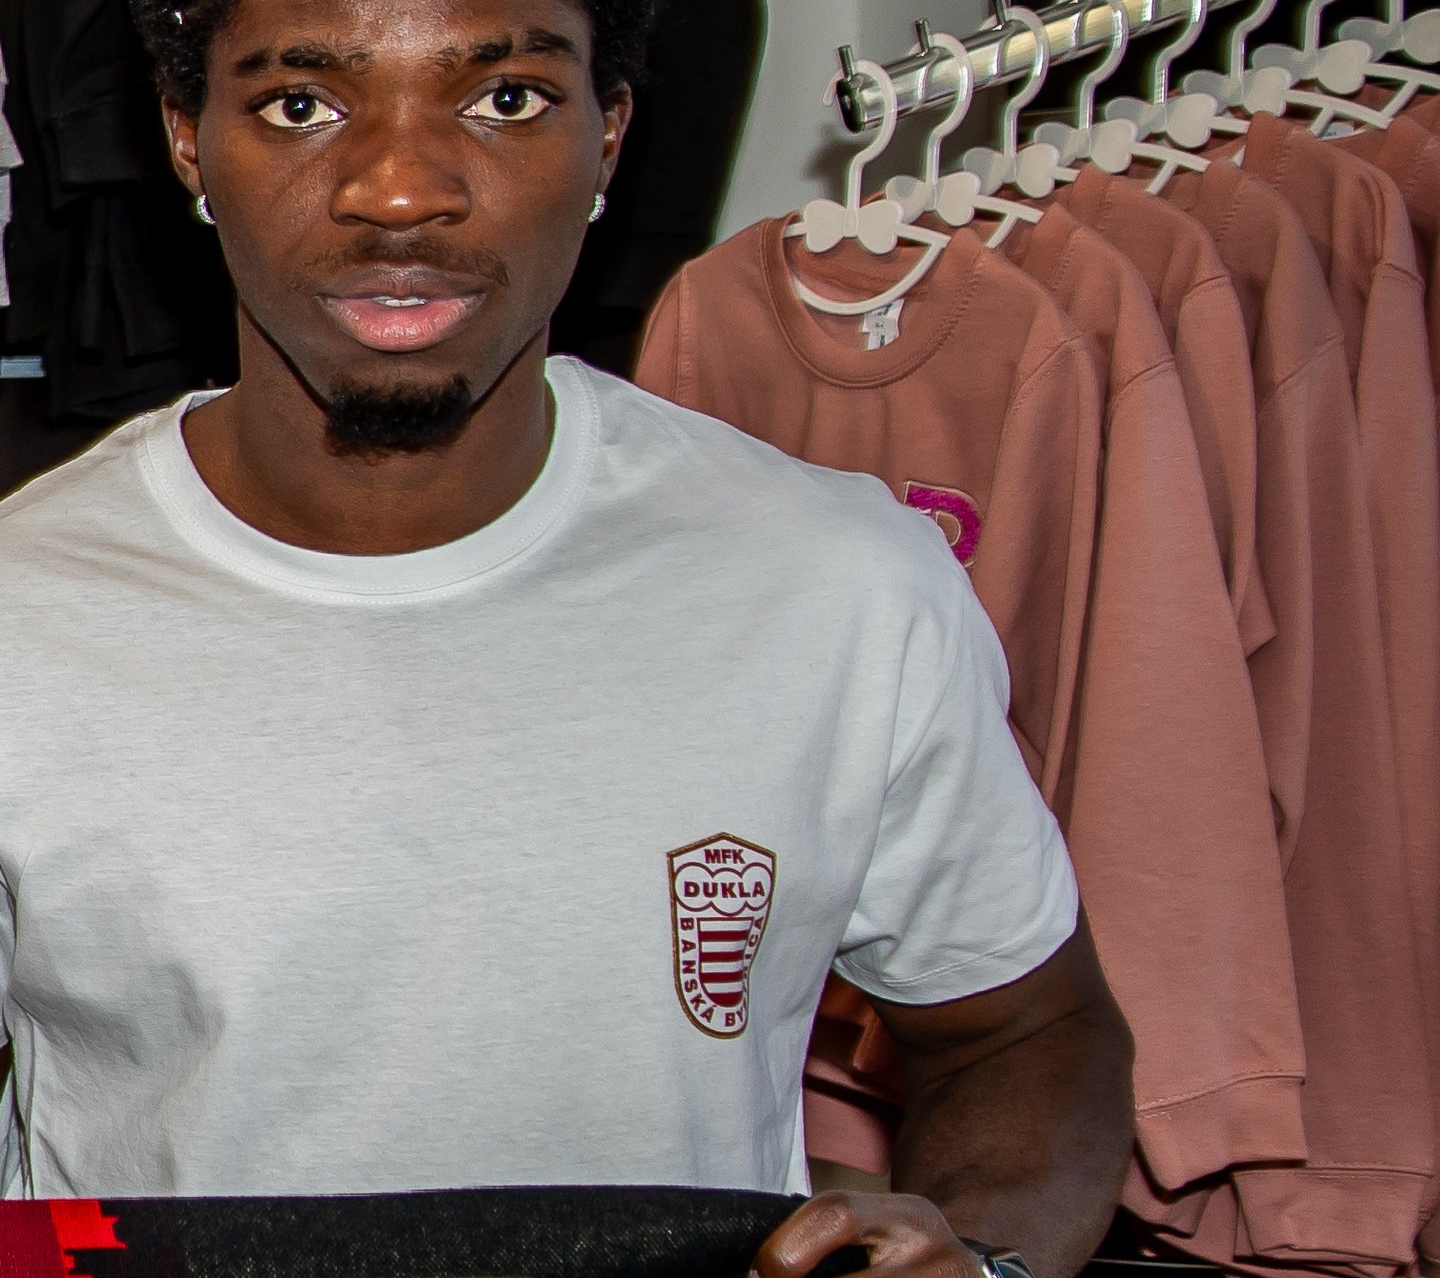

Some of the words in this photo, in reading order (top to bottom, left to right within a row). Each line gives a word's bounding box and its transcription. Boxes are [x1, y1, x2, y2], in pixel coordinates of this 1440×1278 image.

[704, 849, 746, 865] MFK
[683, 880, 766, 899] DUKLA
[679, 917, 717, 1023] BANSKÁ
